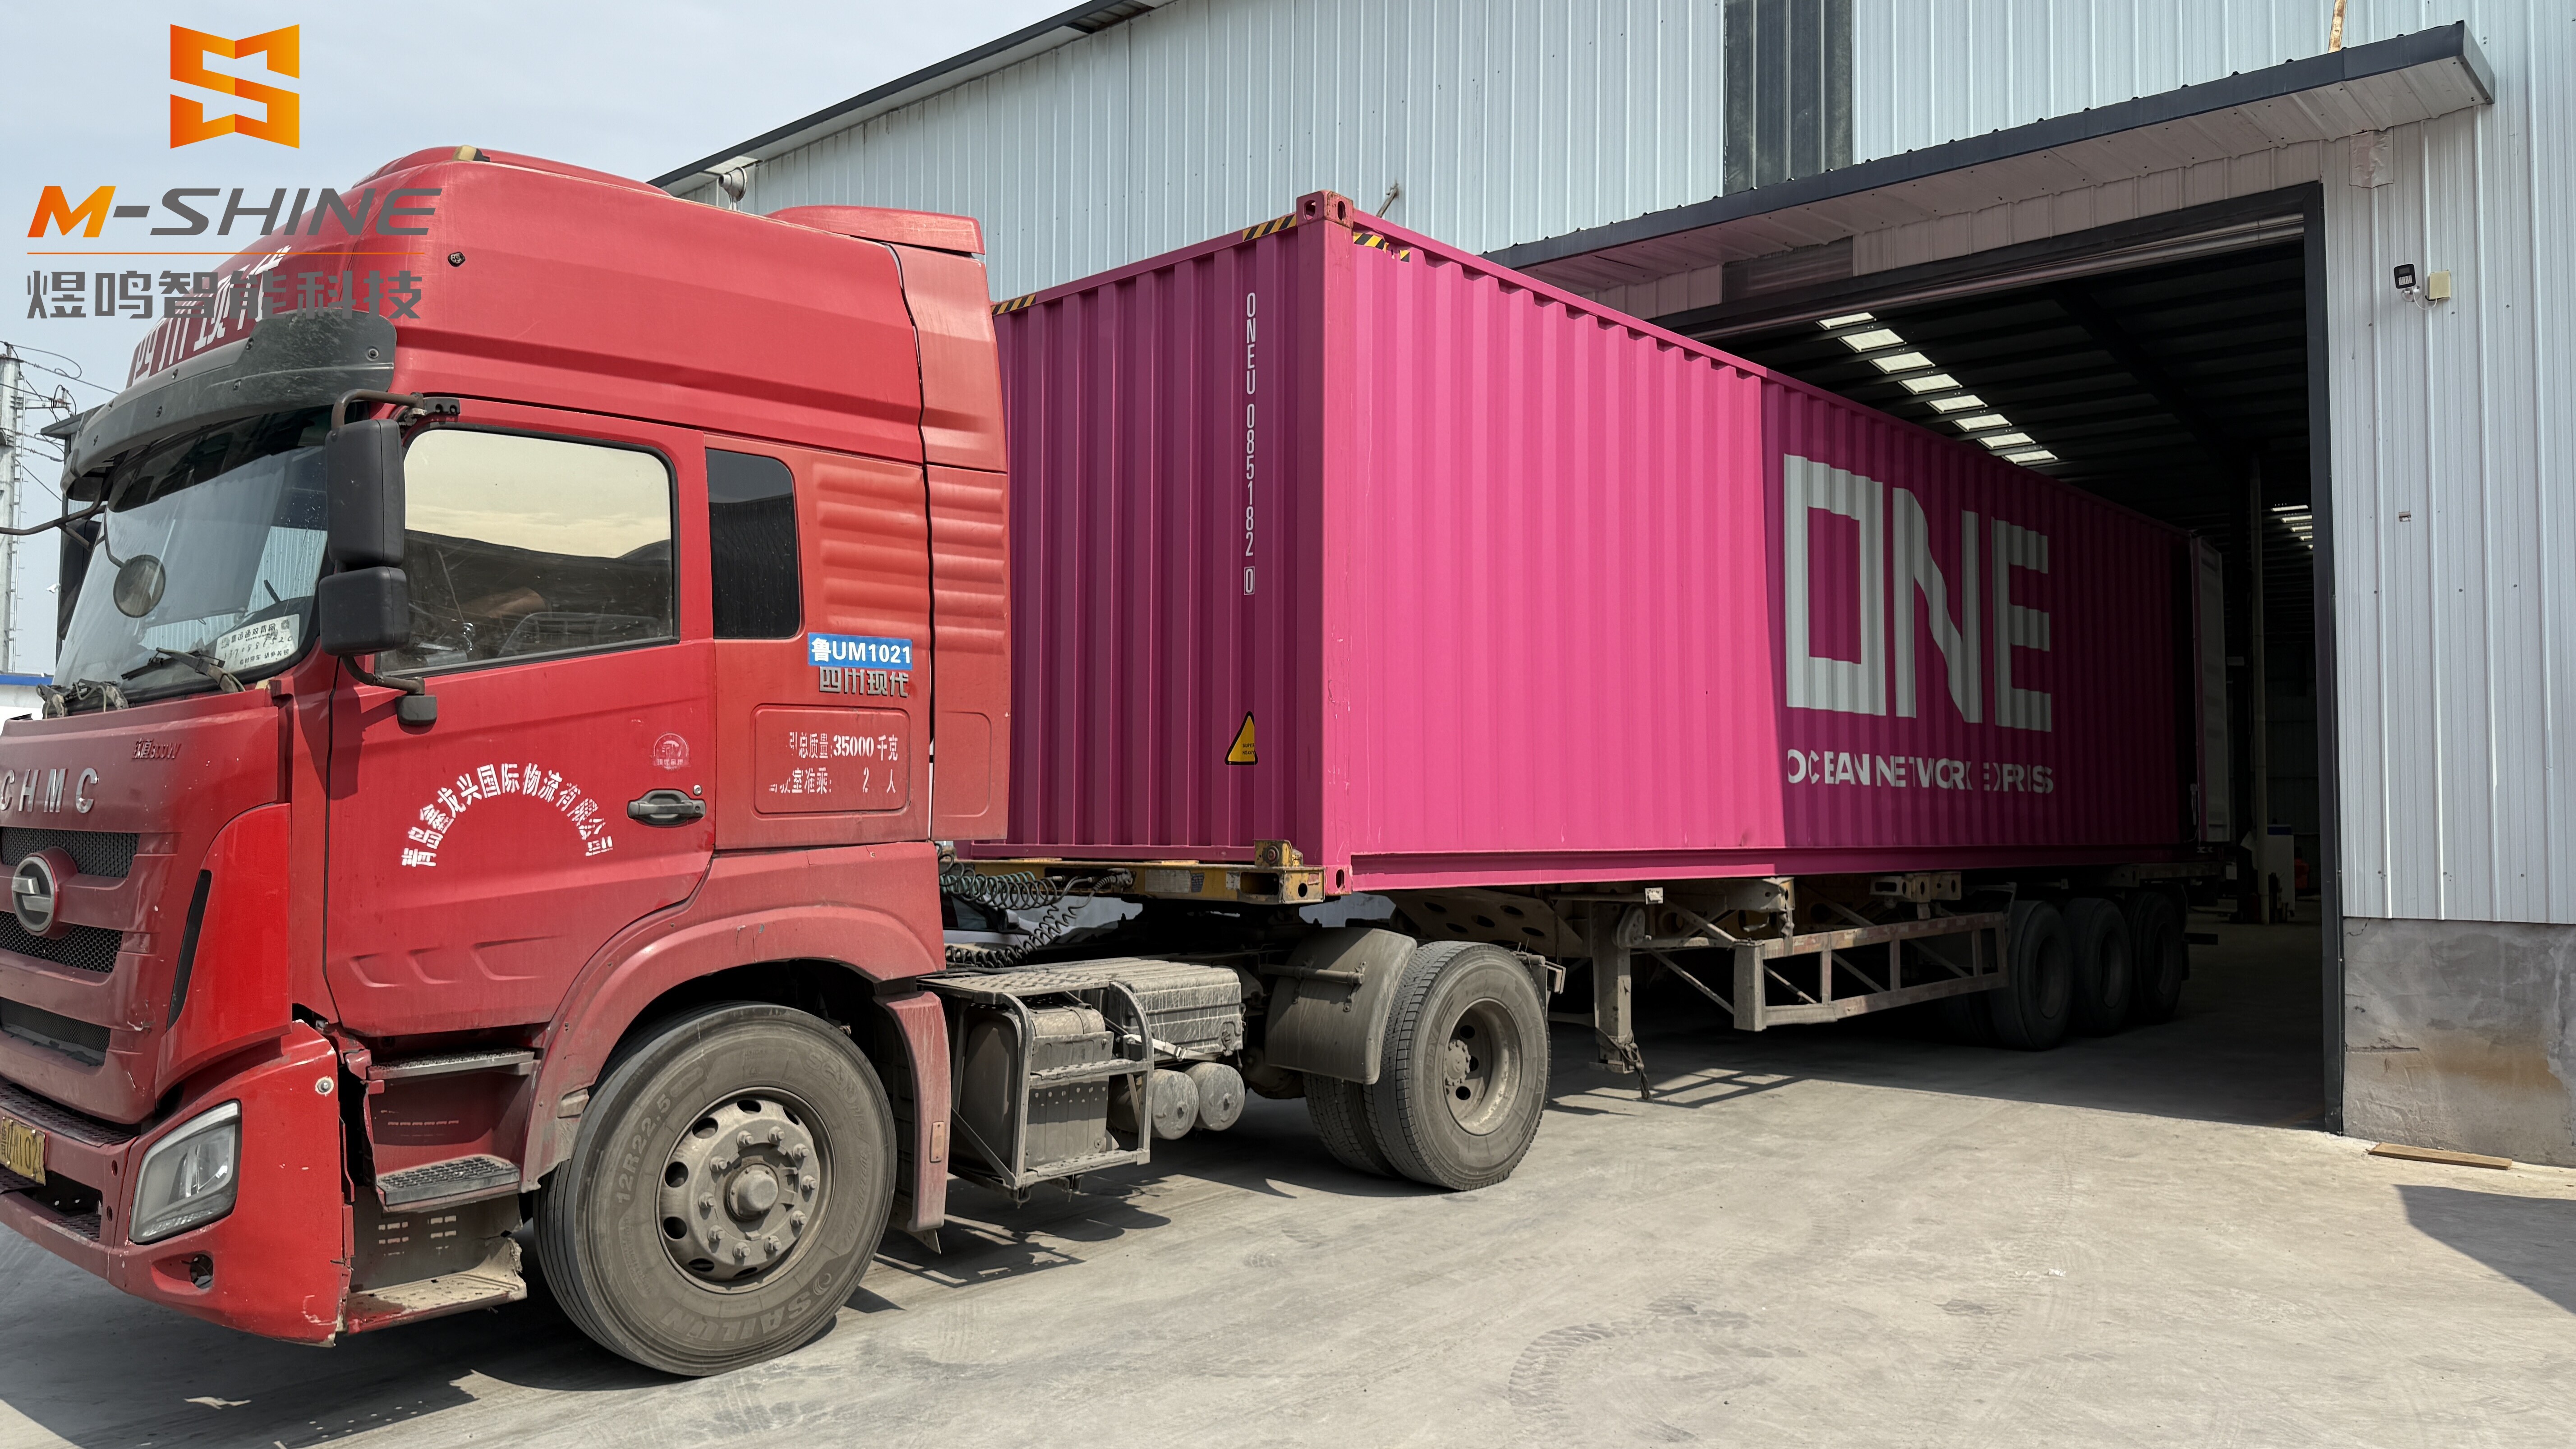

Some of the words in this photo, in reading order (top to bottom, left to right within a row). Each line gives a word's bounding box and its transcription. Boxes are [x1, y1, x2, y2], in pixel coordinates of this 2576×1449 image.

[1247, 292, 1256, 395] ONEU
[1246, 404, 1255, 557] 085182
[1784, 453, 2052, 733] ONE
[812, 638, 911, 664] 鲁UM1021
[819, 666, 909, 699] 四川现代
